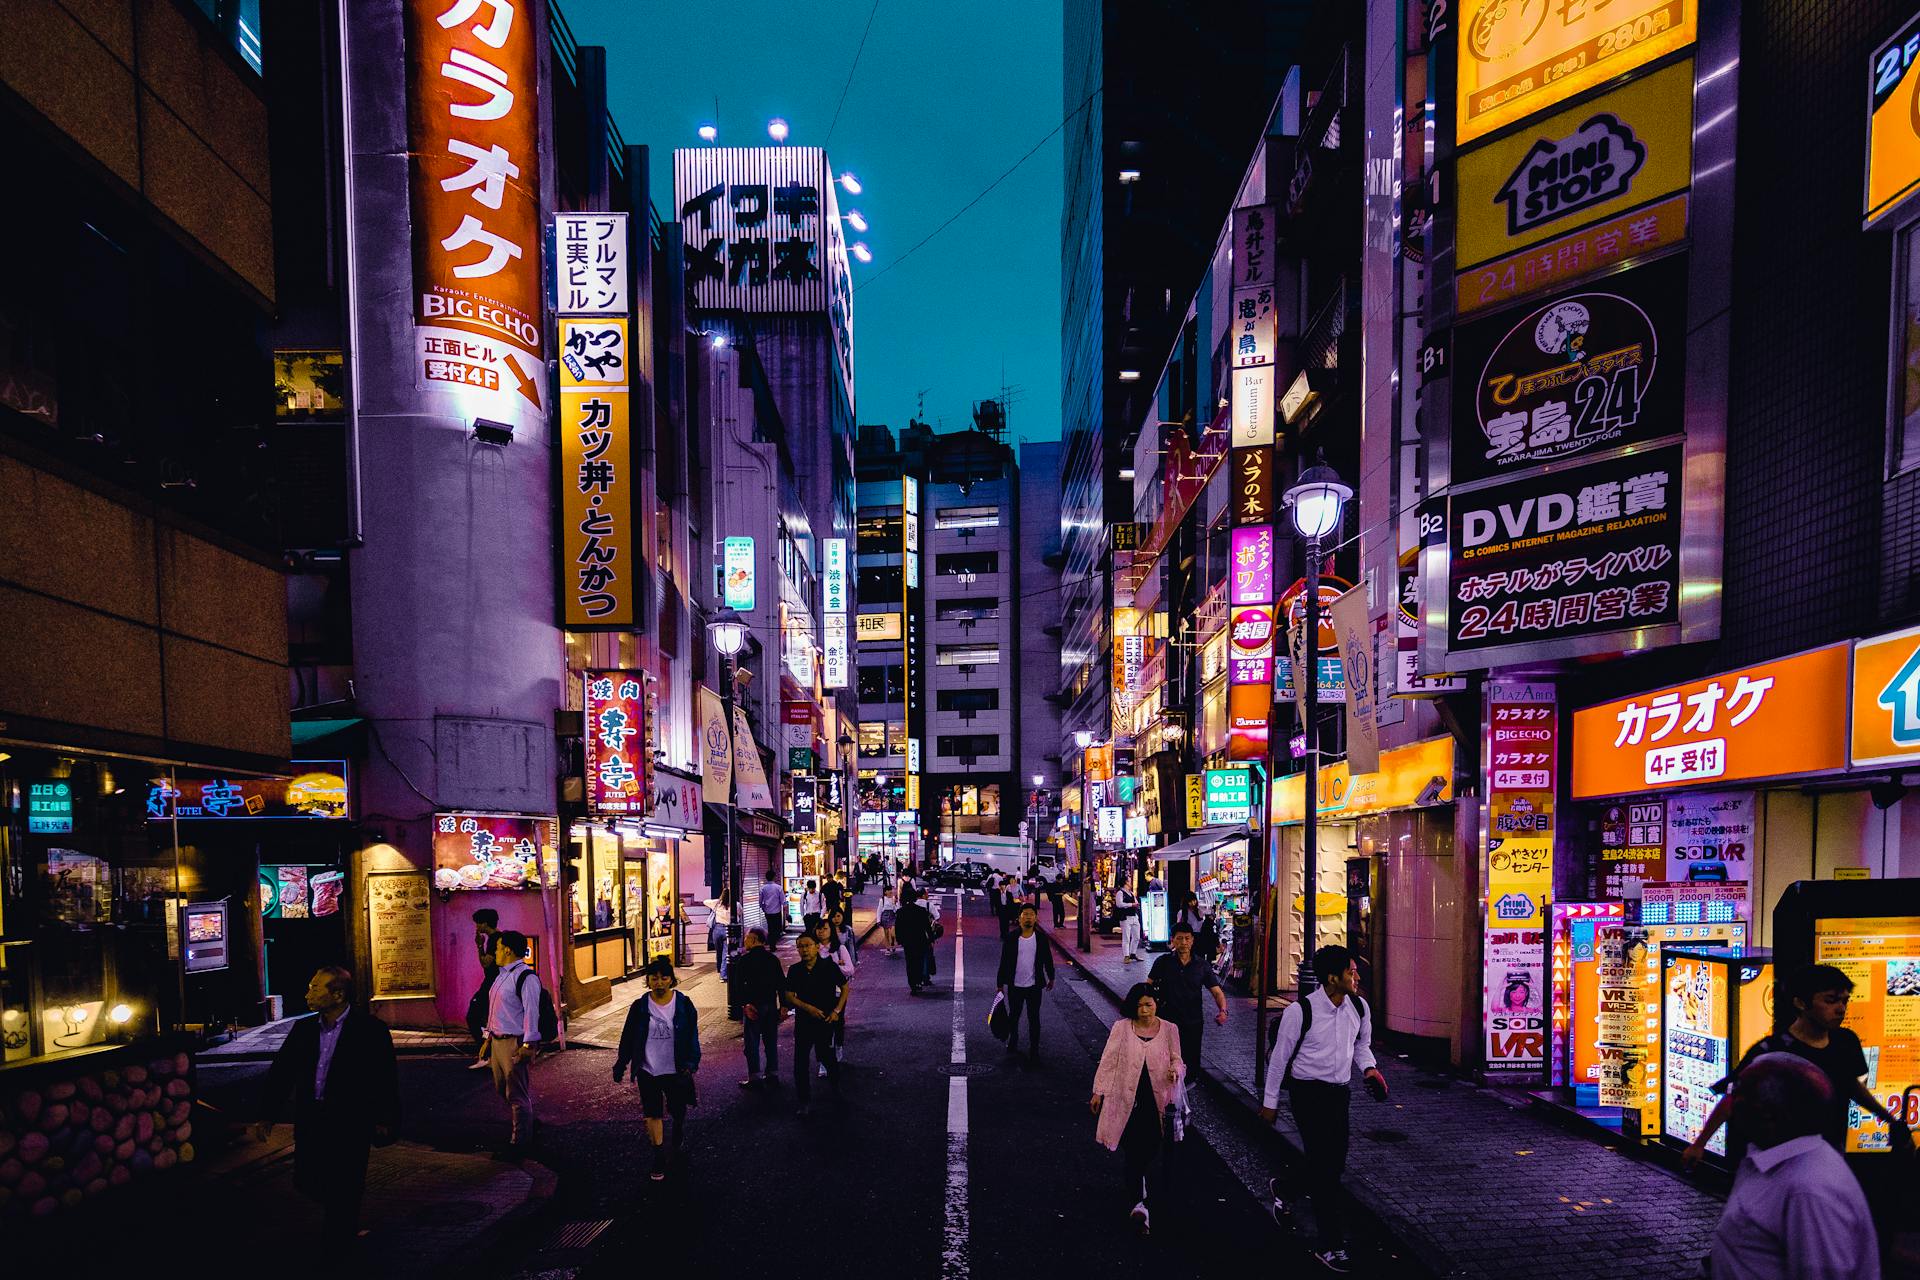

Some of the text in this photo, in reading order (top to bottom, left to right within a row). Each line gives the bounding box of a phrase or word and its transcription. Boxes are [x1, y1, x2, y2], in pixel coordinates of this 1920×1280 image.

[436, 0, 522, 279] カラオケ
[1528, 136, 1610, 191] MINI
[1524, 163, 1615, 218] STOP
[565, 219, 590, 310] 正実ビル
[595, 218, 617, 309] ブルマン
[1479, 215, 1661, 292] 24時間営業
[433, 284, 530, 321] Karaoke Entertainment
[423, 293, 540, 348] BIG ECHO
[1537, 304, 1585, 353] personal room
[424, 337, 498, 364] 正面ビル
[1423, 346, 1444, 374] B1
[428, 360, 498, 385] 受付4F
[1245, 376, 1264, 386] Bar
[1247, 387, 1258, 439] Geranium
[1485, 364, 1641, 461] 宝島24
[1496, 446, 1553, 466] TAKARAJIMA
[1242, 450, 1265, 515] バラの木
[578, 397, 617, 619] カツ丼・とんかつ
[1463, 470, 1669, 548] DVD鑑賞
[1420, 512, 1443, 538] B2
[1463, 511, 1668, 559] CS COMICS INTERNET MAGAZINE RELAXATION
[1457, 543, 1673, 602] ホテルがライバル
[829, 569, 841, 609] 渋谷会
[1457, 581, 1672, 640] 24時間営業
[859, 617, 885, 631] 和民
[1233, 620, 1271, 640] 楽園
[1236, 669, 1265, 680] 右折
[1496, 708, 1550, 720] カラオケ
[1614, 675, 1775, 749] カラオケ
[1495, 729, 1551, 741] BIG ECHO
[1495, 752, 1550, 765] カラオケ
[1650, 747, 1718, 776] 4F 受付
[1225, 775, 1246, 786] 日立
[1498, 773, 1545, 785] 4F 受付
[604, 791, 627, 799] JUTEI
[1497, 814, 1549, 831] 腹八分目
[1631, 806, 1661, 823] DVD
[1489, 840, 1501, 849] 2F
[1511, 848, 1548, 860] やきとり
[1512, 862, 1550, 873] センター
[1644, 894, 1674, 902] 1500円
[1680, 893, 1711, 902] 2000円
[1502, 907, 1527, 916] STOP
[1741, 967, 1758, 980] 2F
[1602, 989, 1626, 1001] VR
[1492, 1018, 1544, 1030] SOD
[1491, 1032, 1544, 1058] VR
